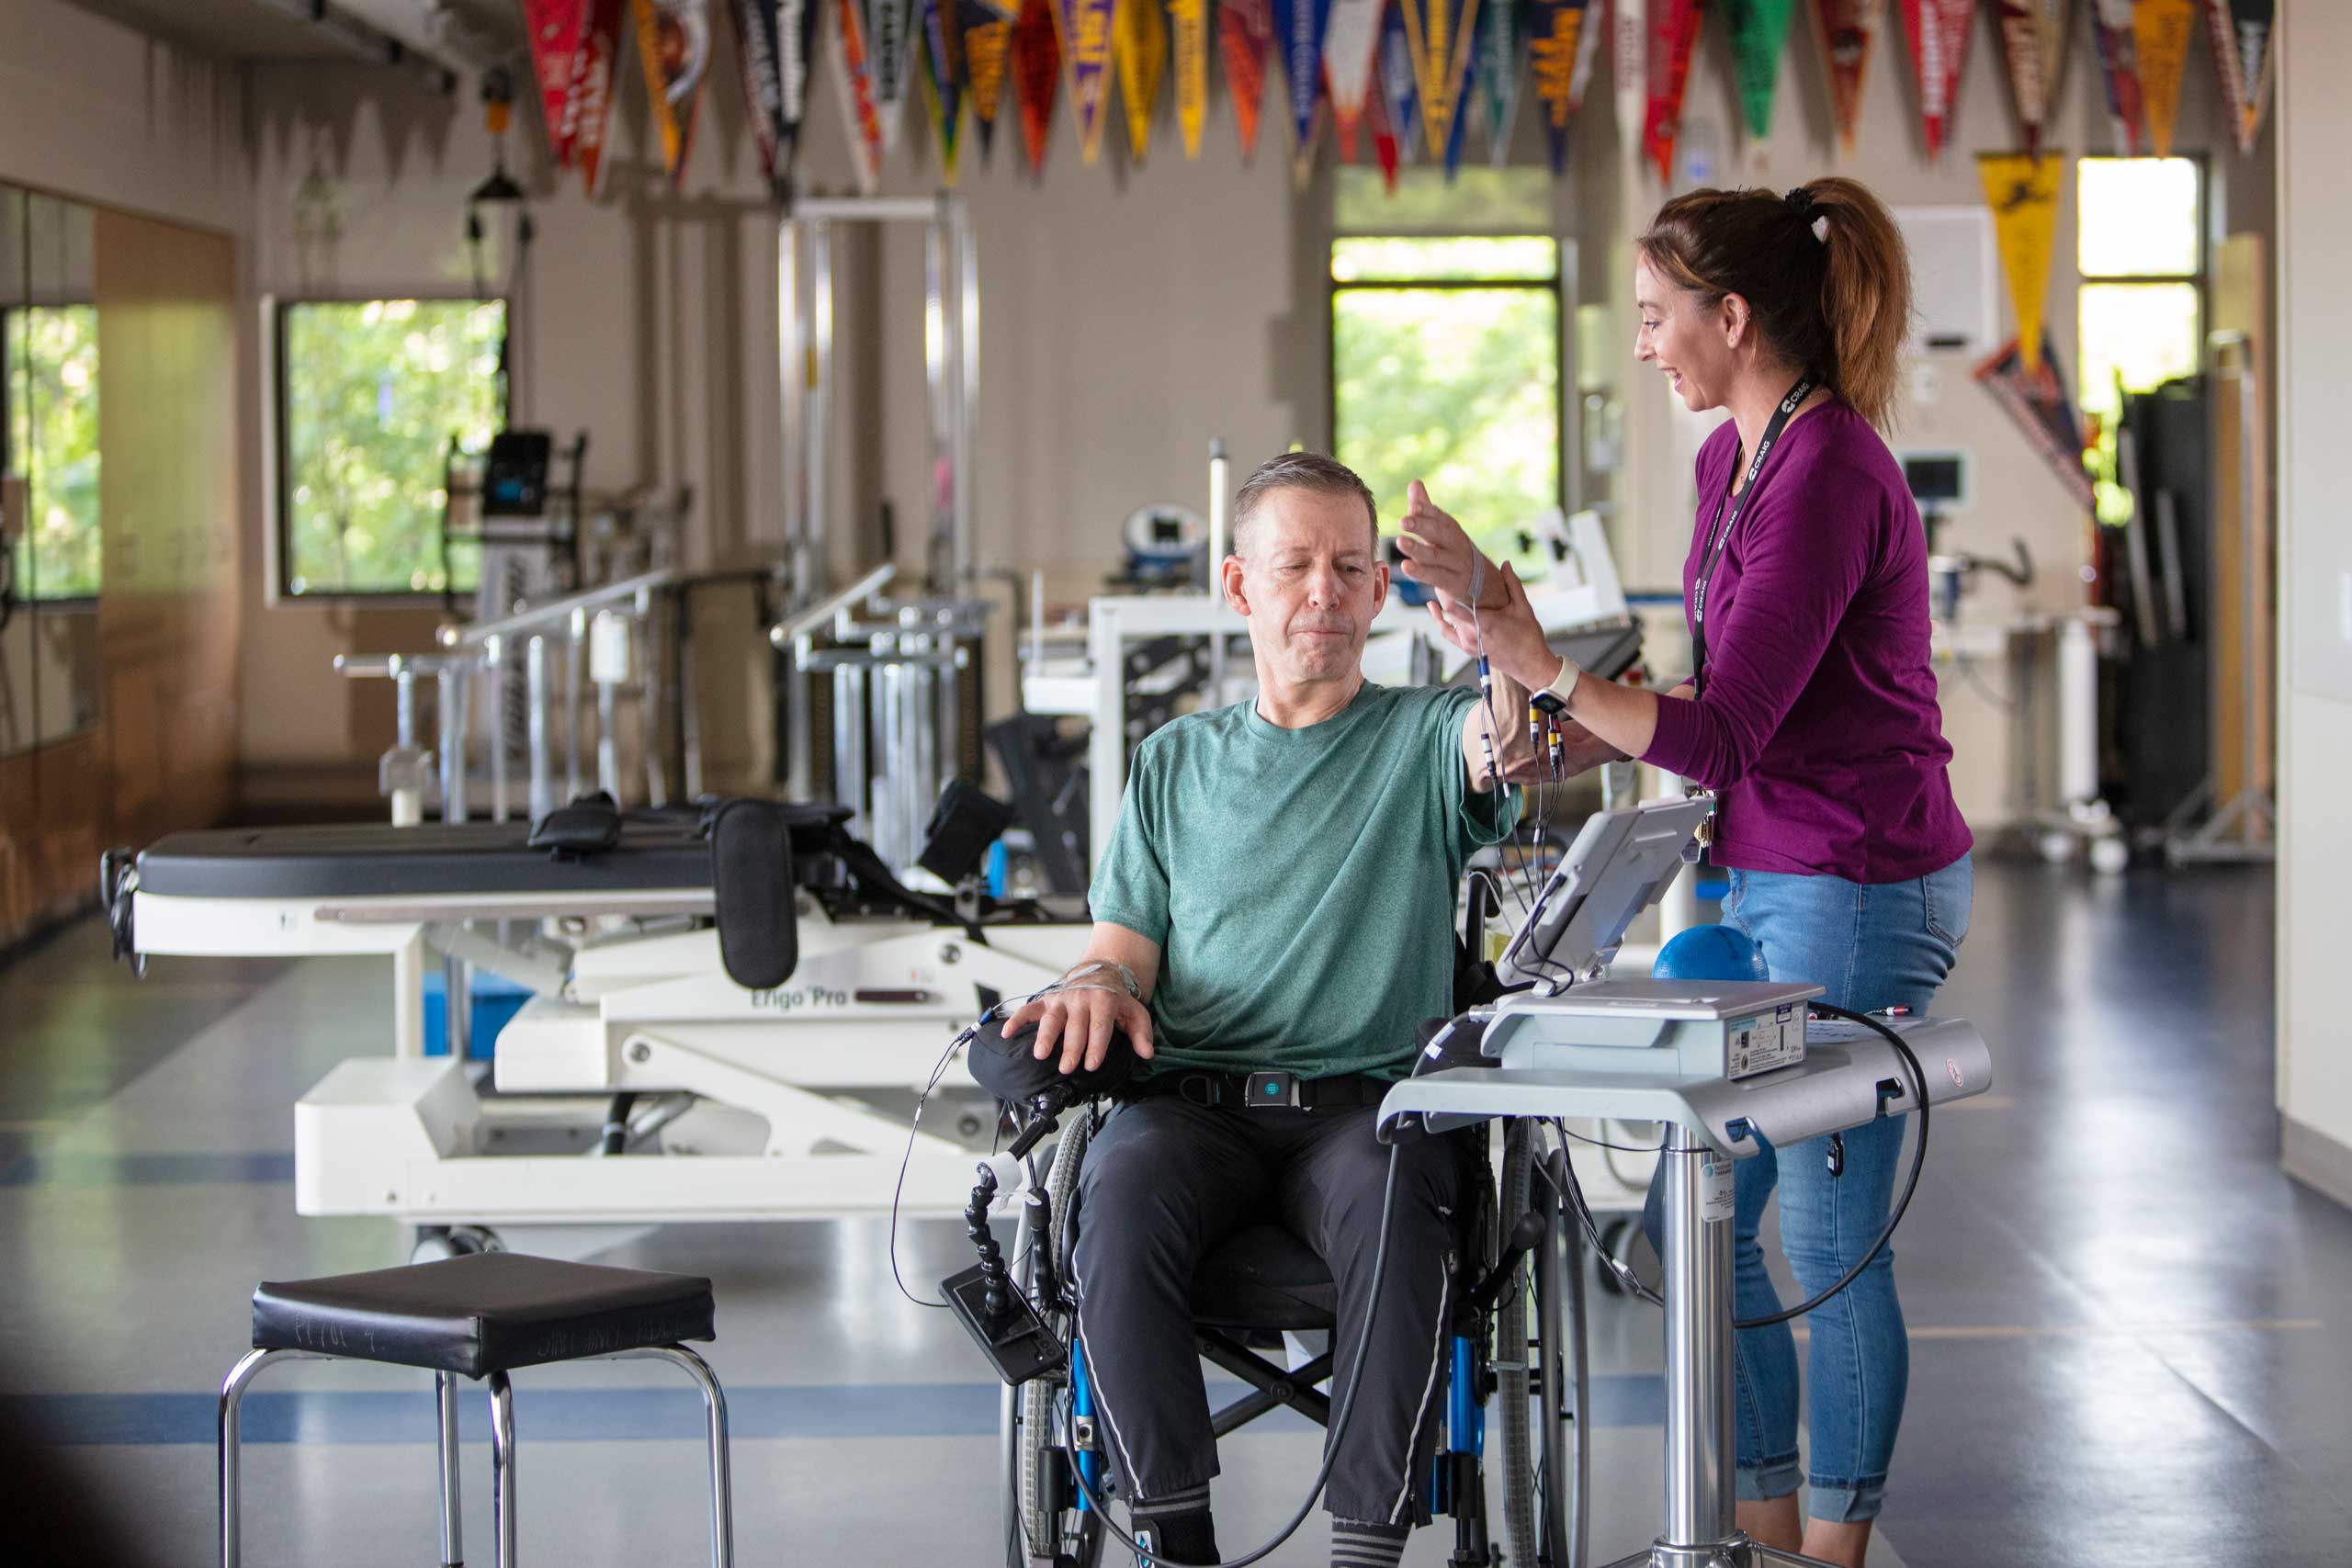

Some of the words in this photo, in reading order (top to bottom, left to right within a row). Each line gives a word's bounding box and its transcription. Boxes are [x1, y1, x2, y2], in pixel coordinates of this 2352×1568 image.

[1791, 382, 1810, 402] CRAIG
[1754, 440, 1770, 469] CRAIG
[1723, 510, 1737, 540] CRAIG
[1698, 580, 1707, 610] CRAIG
[752, 988, 804, 1012] Erigo
[813, 987, 846, 1007] Pro
